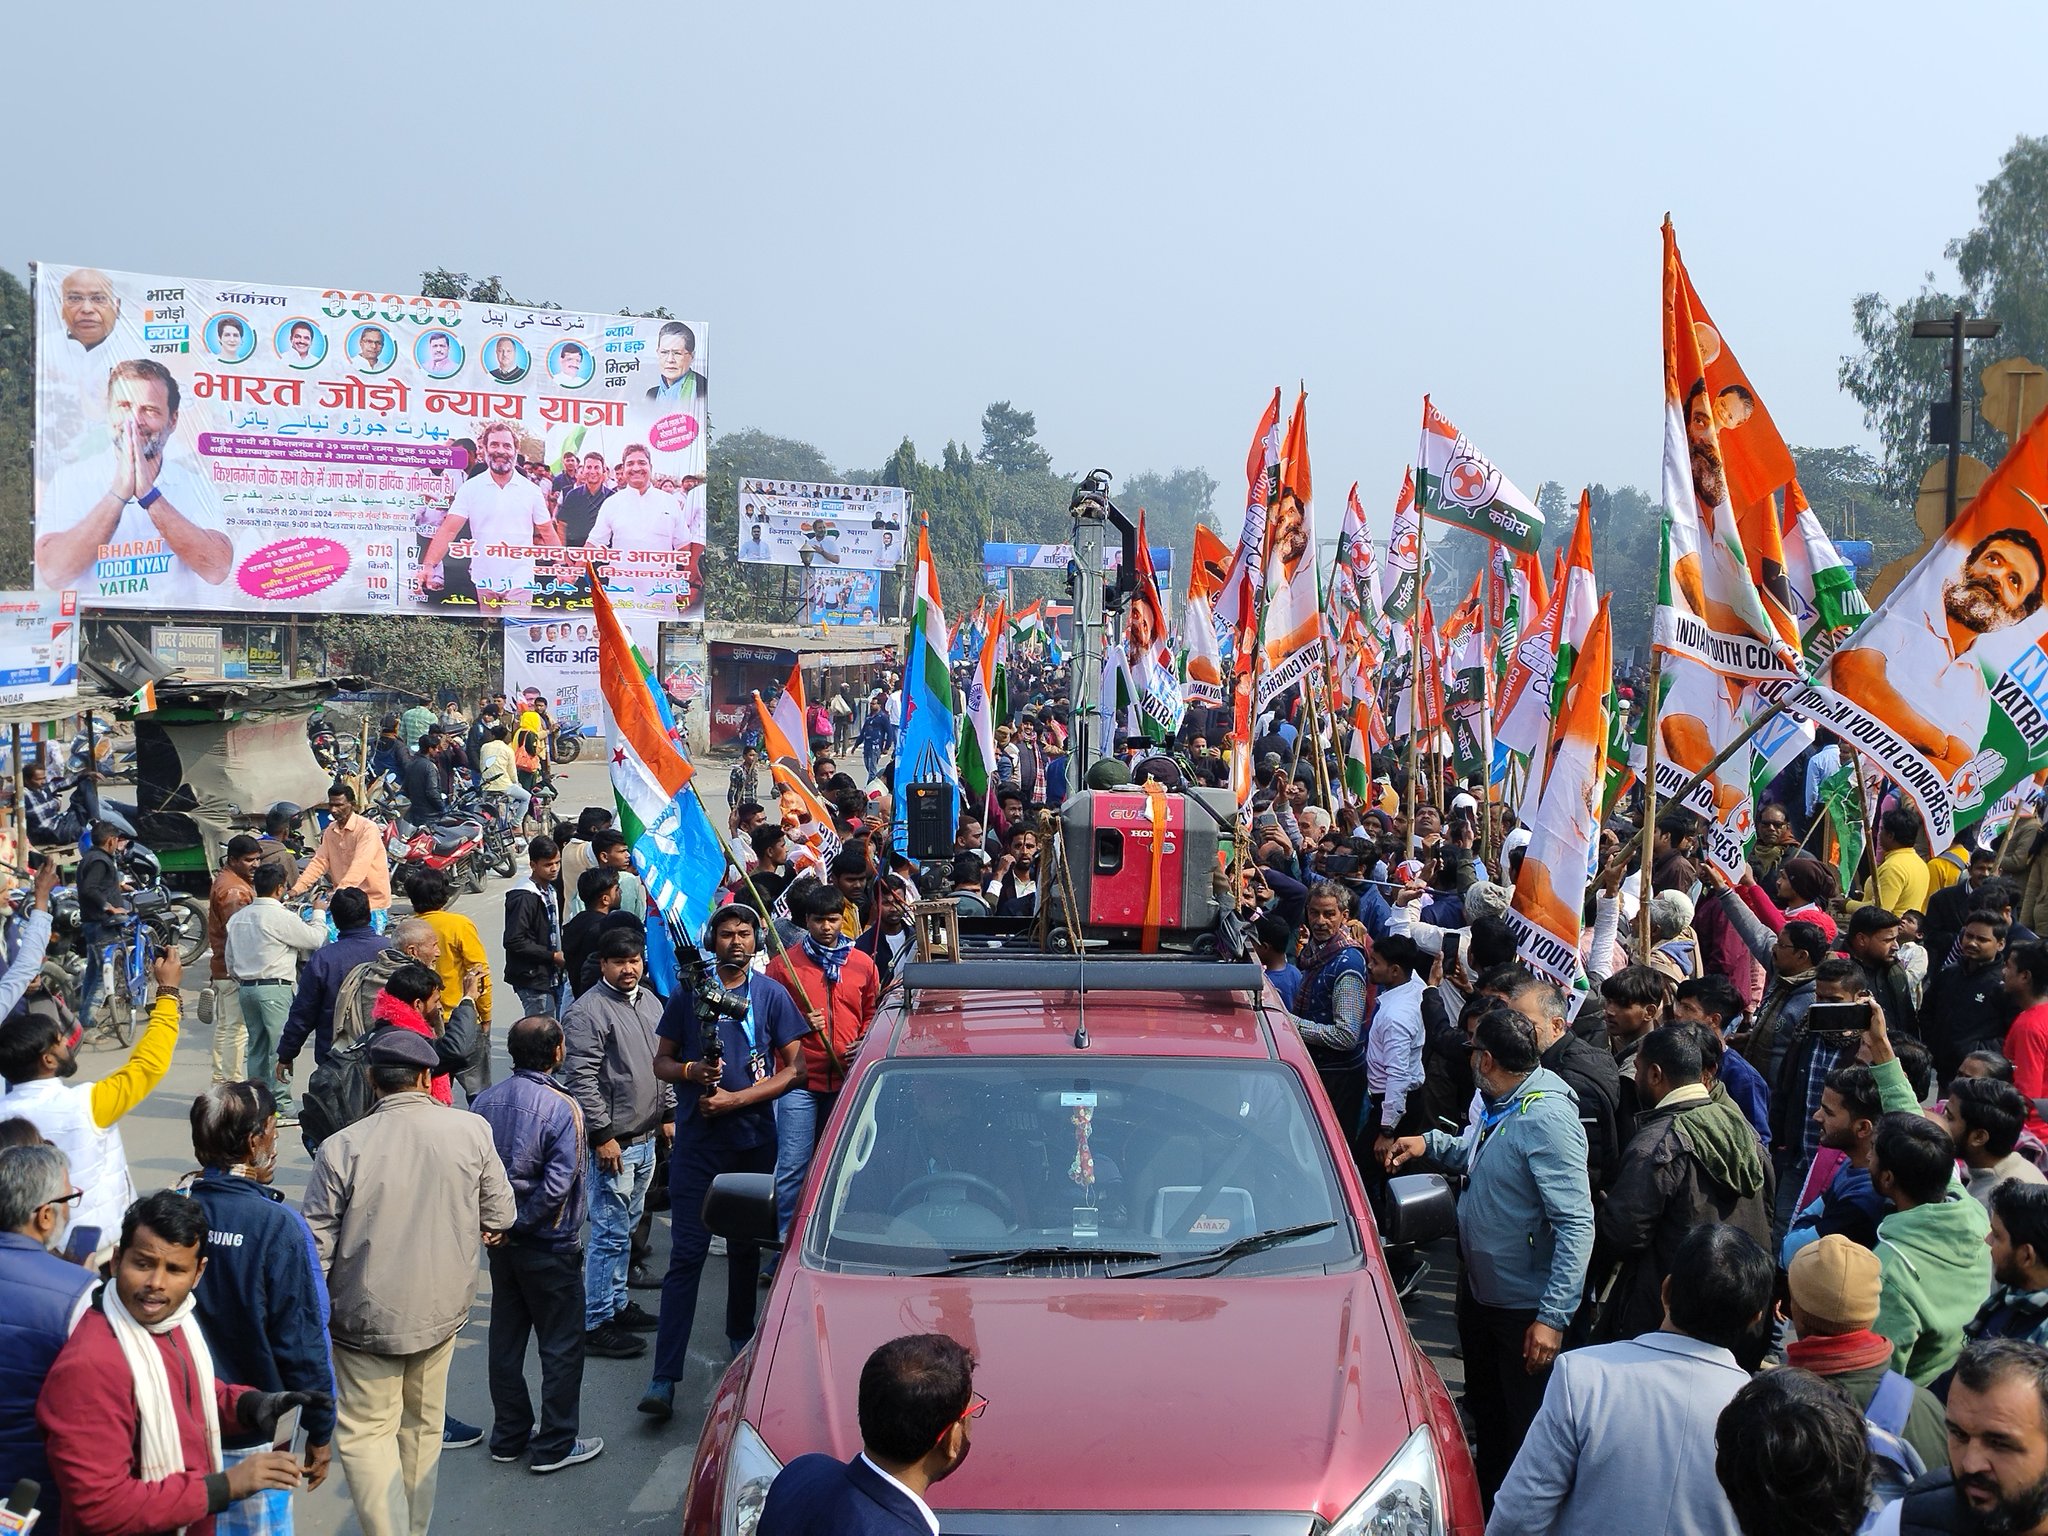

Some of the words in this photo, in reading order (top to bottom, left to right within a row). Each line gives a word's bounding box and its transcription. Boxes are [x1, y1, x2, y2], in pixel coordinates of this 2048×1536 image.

[145, 288, 184, 302] भारत
[216, 290, 287, 307] आमंत्रण
[155, 305, 184, 323] जोड़ो
[147, 327, 186, 340] न्याय
[605, 326, 634, 337] न्याय
[149, 342, 180, 354] यात्रा
[605, 342, 621, 353] का
[605, 357, 640, 374] मिलने
[605, 376, 627, 387] तक
[194, 372, 305, 406] भारत
[319, 375, 411, 416] जोड़ो
[425, 389, 527, 420] न्याय
[540, 396, 628, 430] यात्रा
[395, 420, 450, 441] بھارت
[314, 510, 332, 518] 2024
[1489, 508, 1531, 538] कांग्रेस
[98, 538, 164, 560] BHARAT
[367, 545, 393, 557] 6713
[407, 546, 420, 558] 67
[449, 540, 479, 558] डॉ.
[486, 542, 566, 560] मोहम्मद
[569, 546, 622, 563] जावेद
[627, 551, 691, 567] आज़ाद
[99, 560, 133, 578] JODO
[136, 555, 169, 574] NYAY
[533, 566, 585, 577] सांसद
[598, 566, 691, 579] किशनगंज
[99, 579, 149, 597] YATRA
[367, 577, 387, 589] 110
[407, 578, 418, 590] 15
[179, 633, 217, 648] अस्पताल
[525, 645, 568, 664] हार्दिक
[572, 646, 601, 664] अभि
[733, 648, 752, 660] पुलिस
[754, 648, 777, 661] चौकी
[1745, 645, 1785, 671] CON
[1991, 672, 2048, 747] YATRA
[1845, 714, 1903, 760] YOUTH
[1892, 753, 1951, 837] CONGRESS
